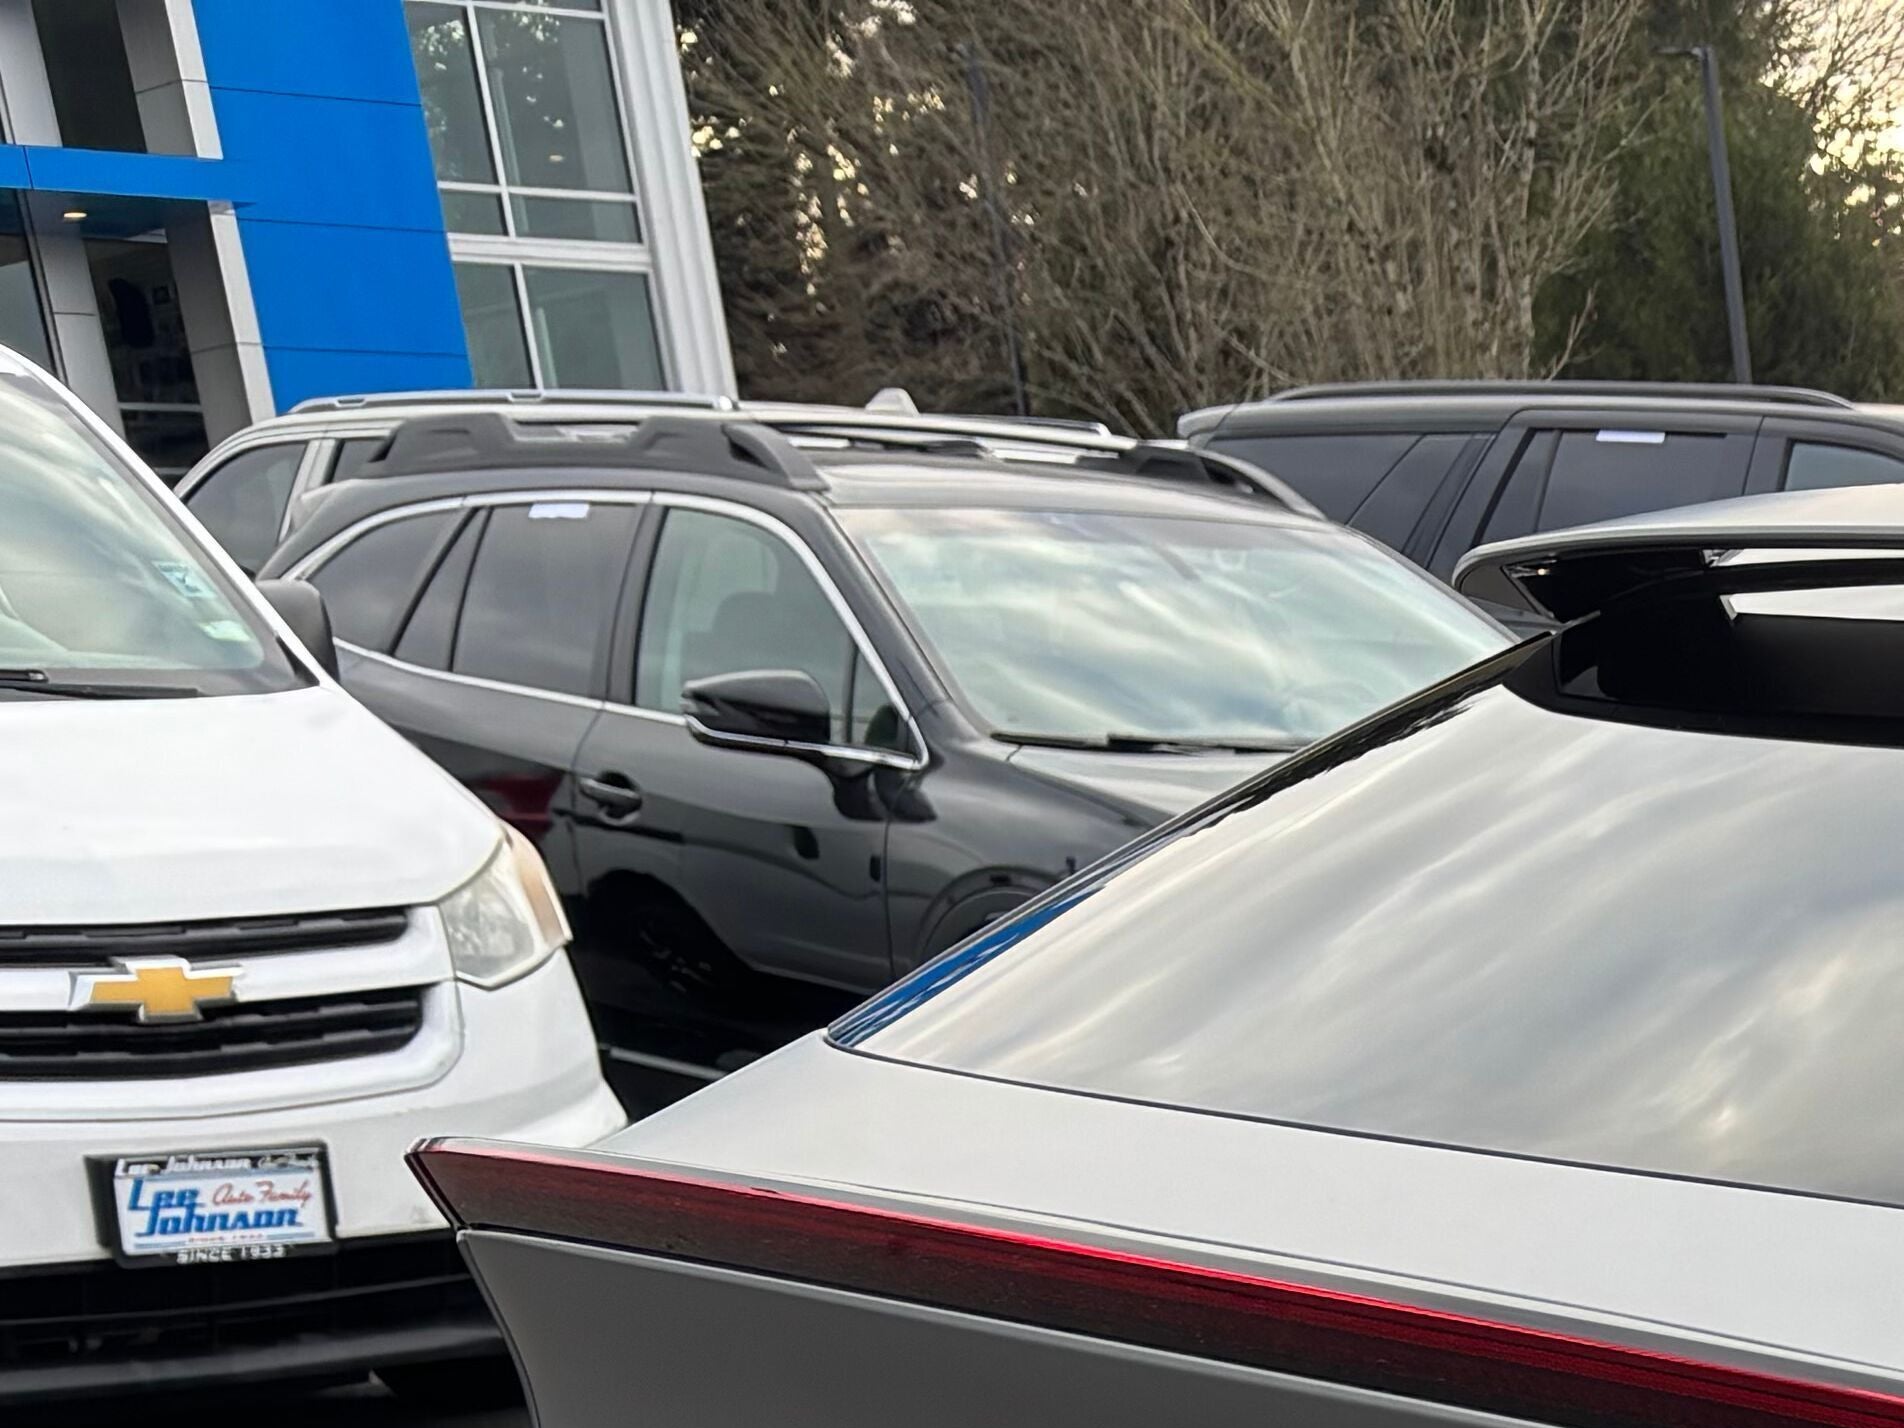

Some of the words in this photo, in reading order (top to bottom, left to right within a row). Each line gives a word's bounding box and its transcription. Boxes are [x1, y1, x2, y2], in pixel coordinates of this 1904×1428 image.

[128, 1176, 205, 1211] Lee
[212, 1183, 254, 1206] Auto
[255, 1179, 312, 1209] Family
[135, 1203, 303, 1238] Johnson
